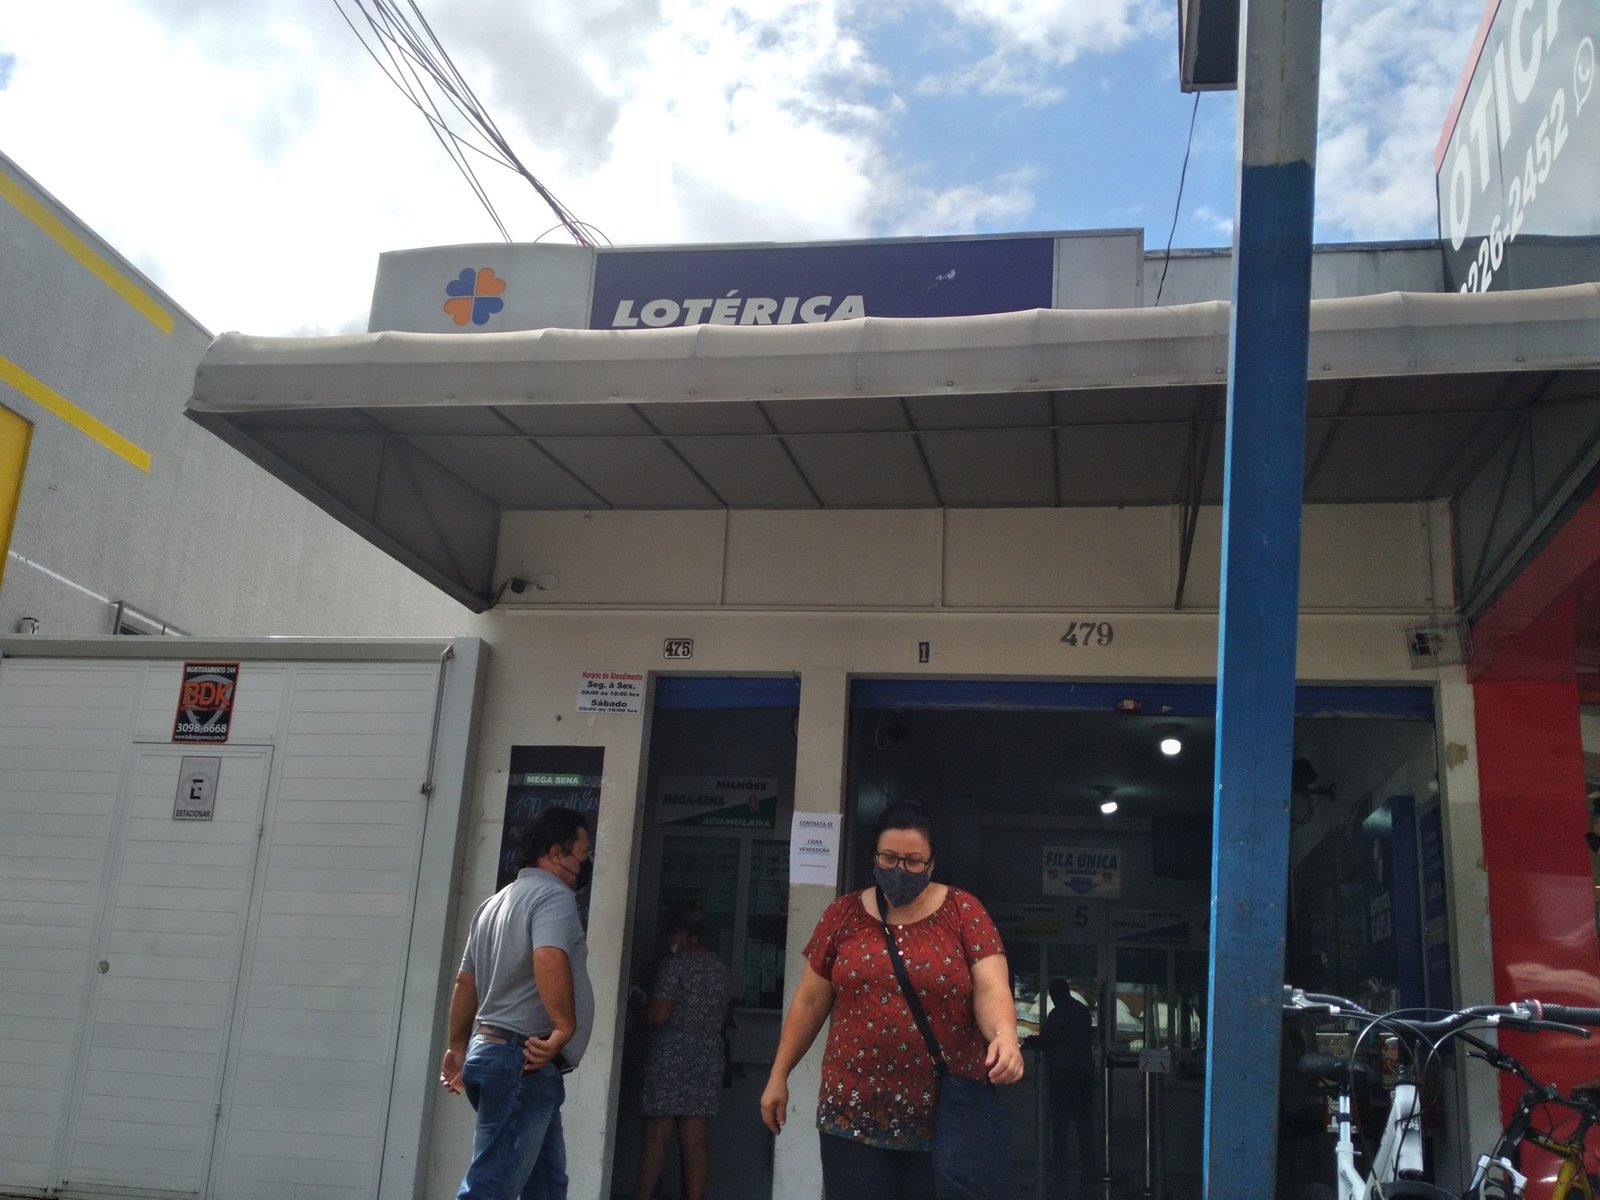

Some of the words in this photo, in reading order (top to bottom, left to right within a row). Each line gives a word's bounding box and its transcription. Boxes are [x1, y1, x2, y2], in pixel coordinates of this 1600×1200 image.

[612, 289, 866, 327] LOTÉRICA
[1060, 622, 1114, 646] 479
[665, 641, 691, 657] 475
[182, 681, 233, 706] BDK
[591, 699, 627, 707] Sábado
[527, 775, 553, 784] MEGA
[555, 776, 579, 784] SENA
[176, 809, 210, 817] ESTACIONAR
[701, 817, 770, 827] ACUMULADA
[1045, 852, 1073, 867] FILA
[1078, 850, 1118, 869] ÚNICA
